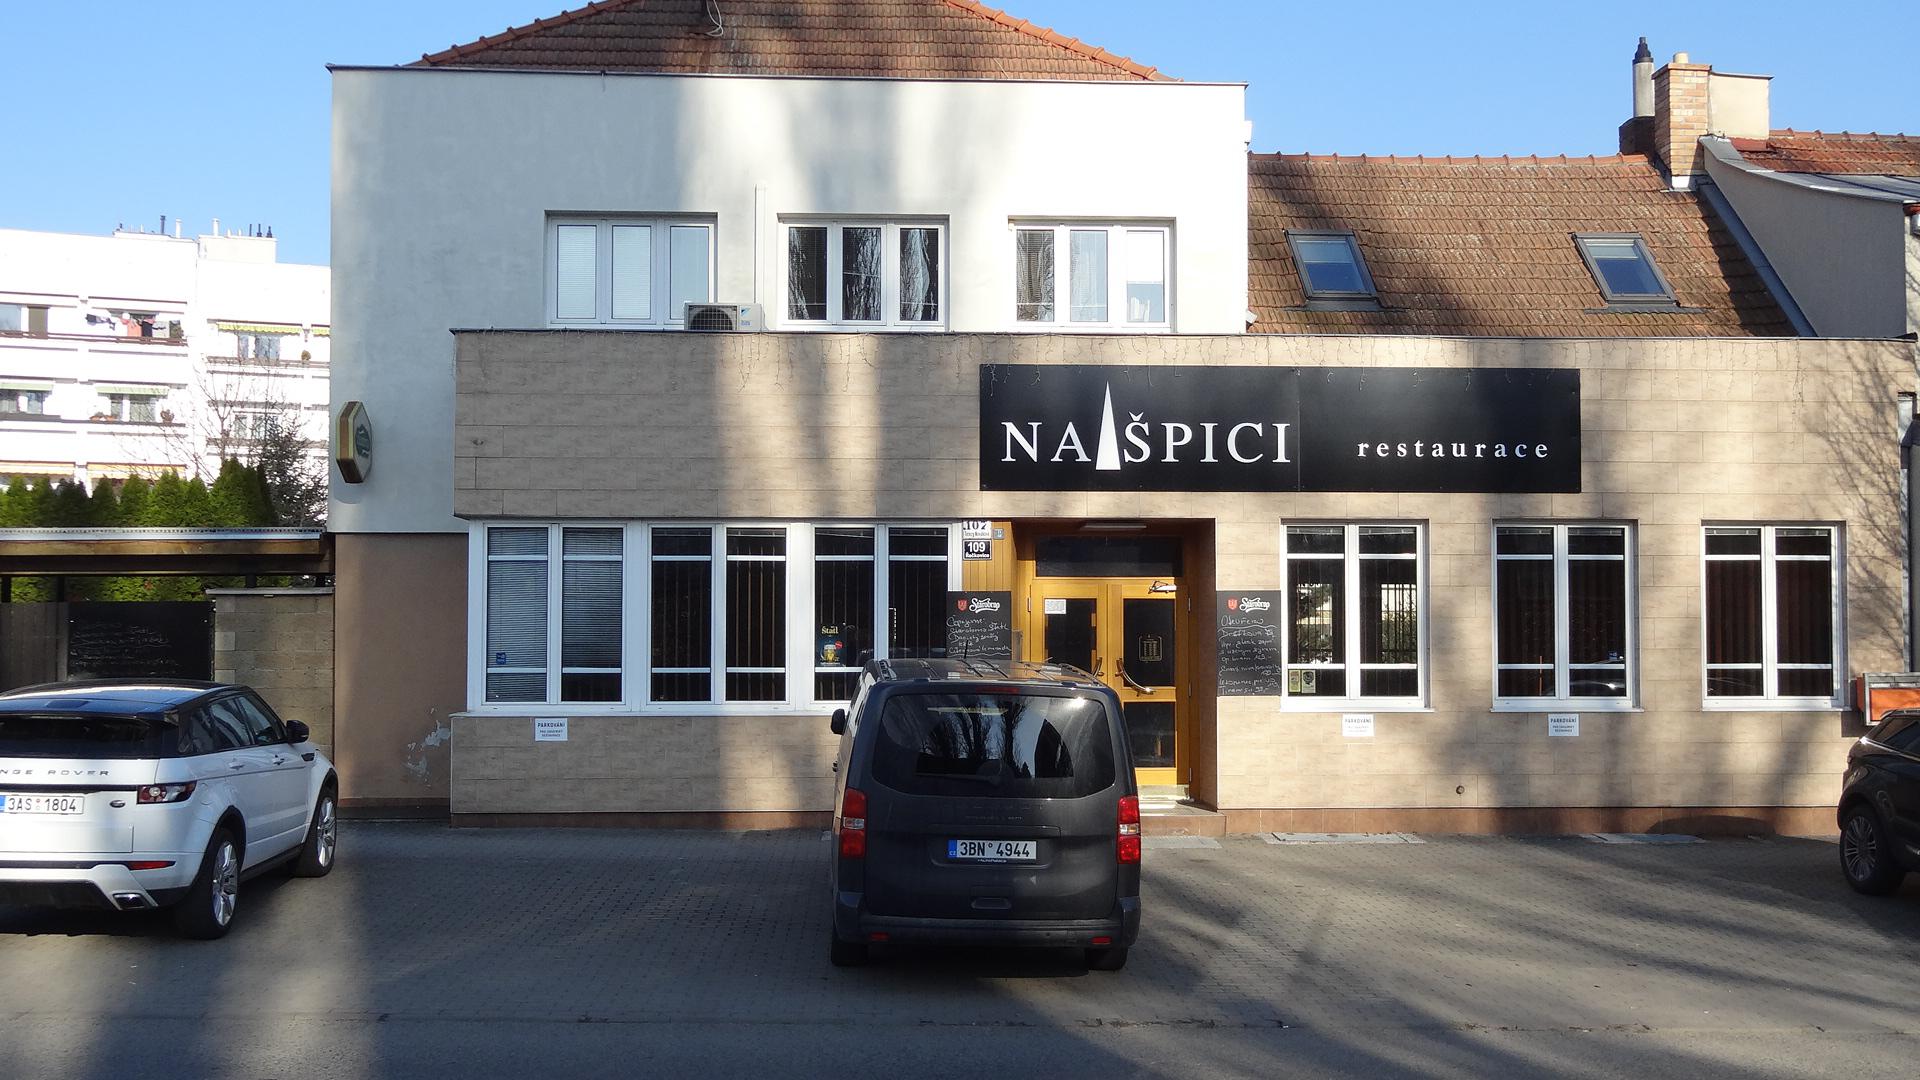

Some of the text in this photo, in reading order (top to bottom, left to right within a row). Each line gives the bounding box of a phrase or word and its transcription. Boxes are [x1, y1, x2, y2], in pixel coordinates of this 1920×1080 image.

[1001, 411, 1291, 463] NA ŠPICI
[1357, 439, 1548, 458] restaurace
[967, 541, 986, 553] 109
[8, 797, 77, 812] 3AS 1804
[960, 841, 986, 856] 3BN
[996, 842, 1030, 857] 4944
